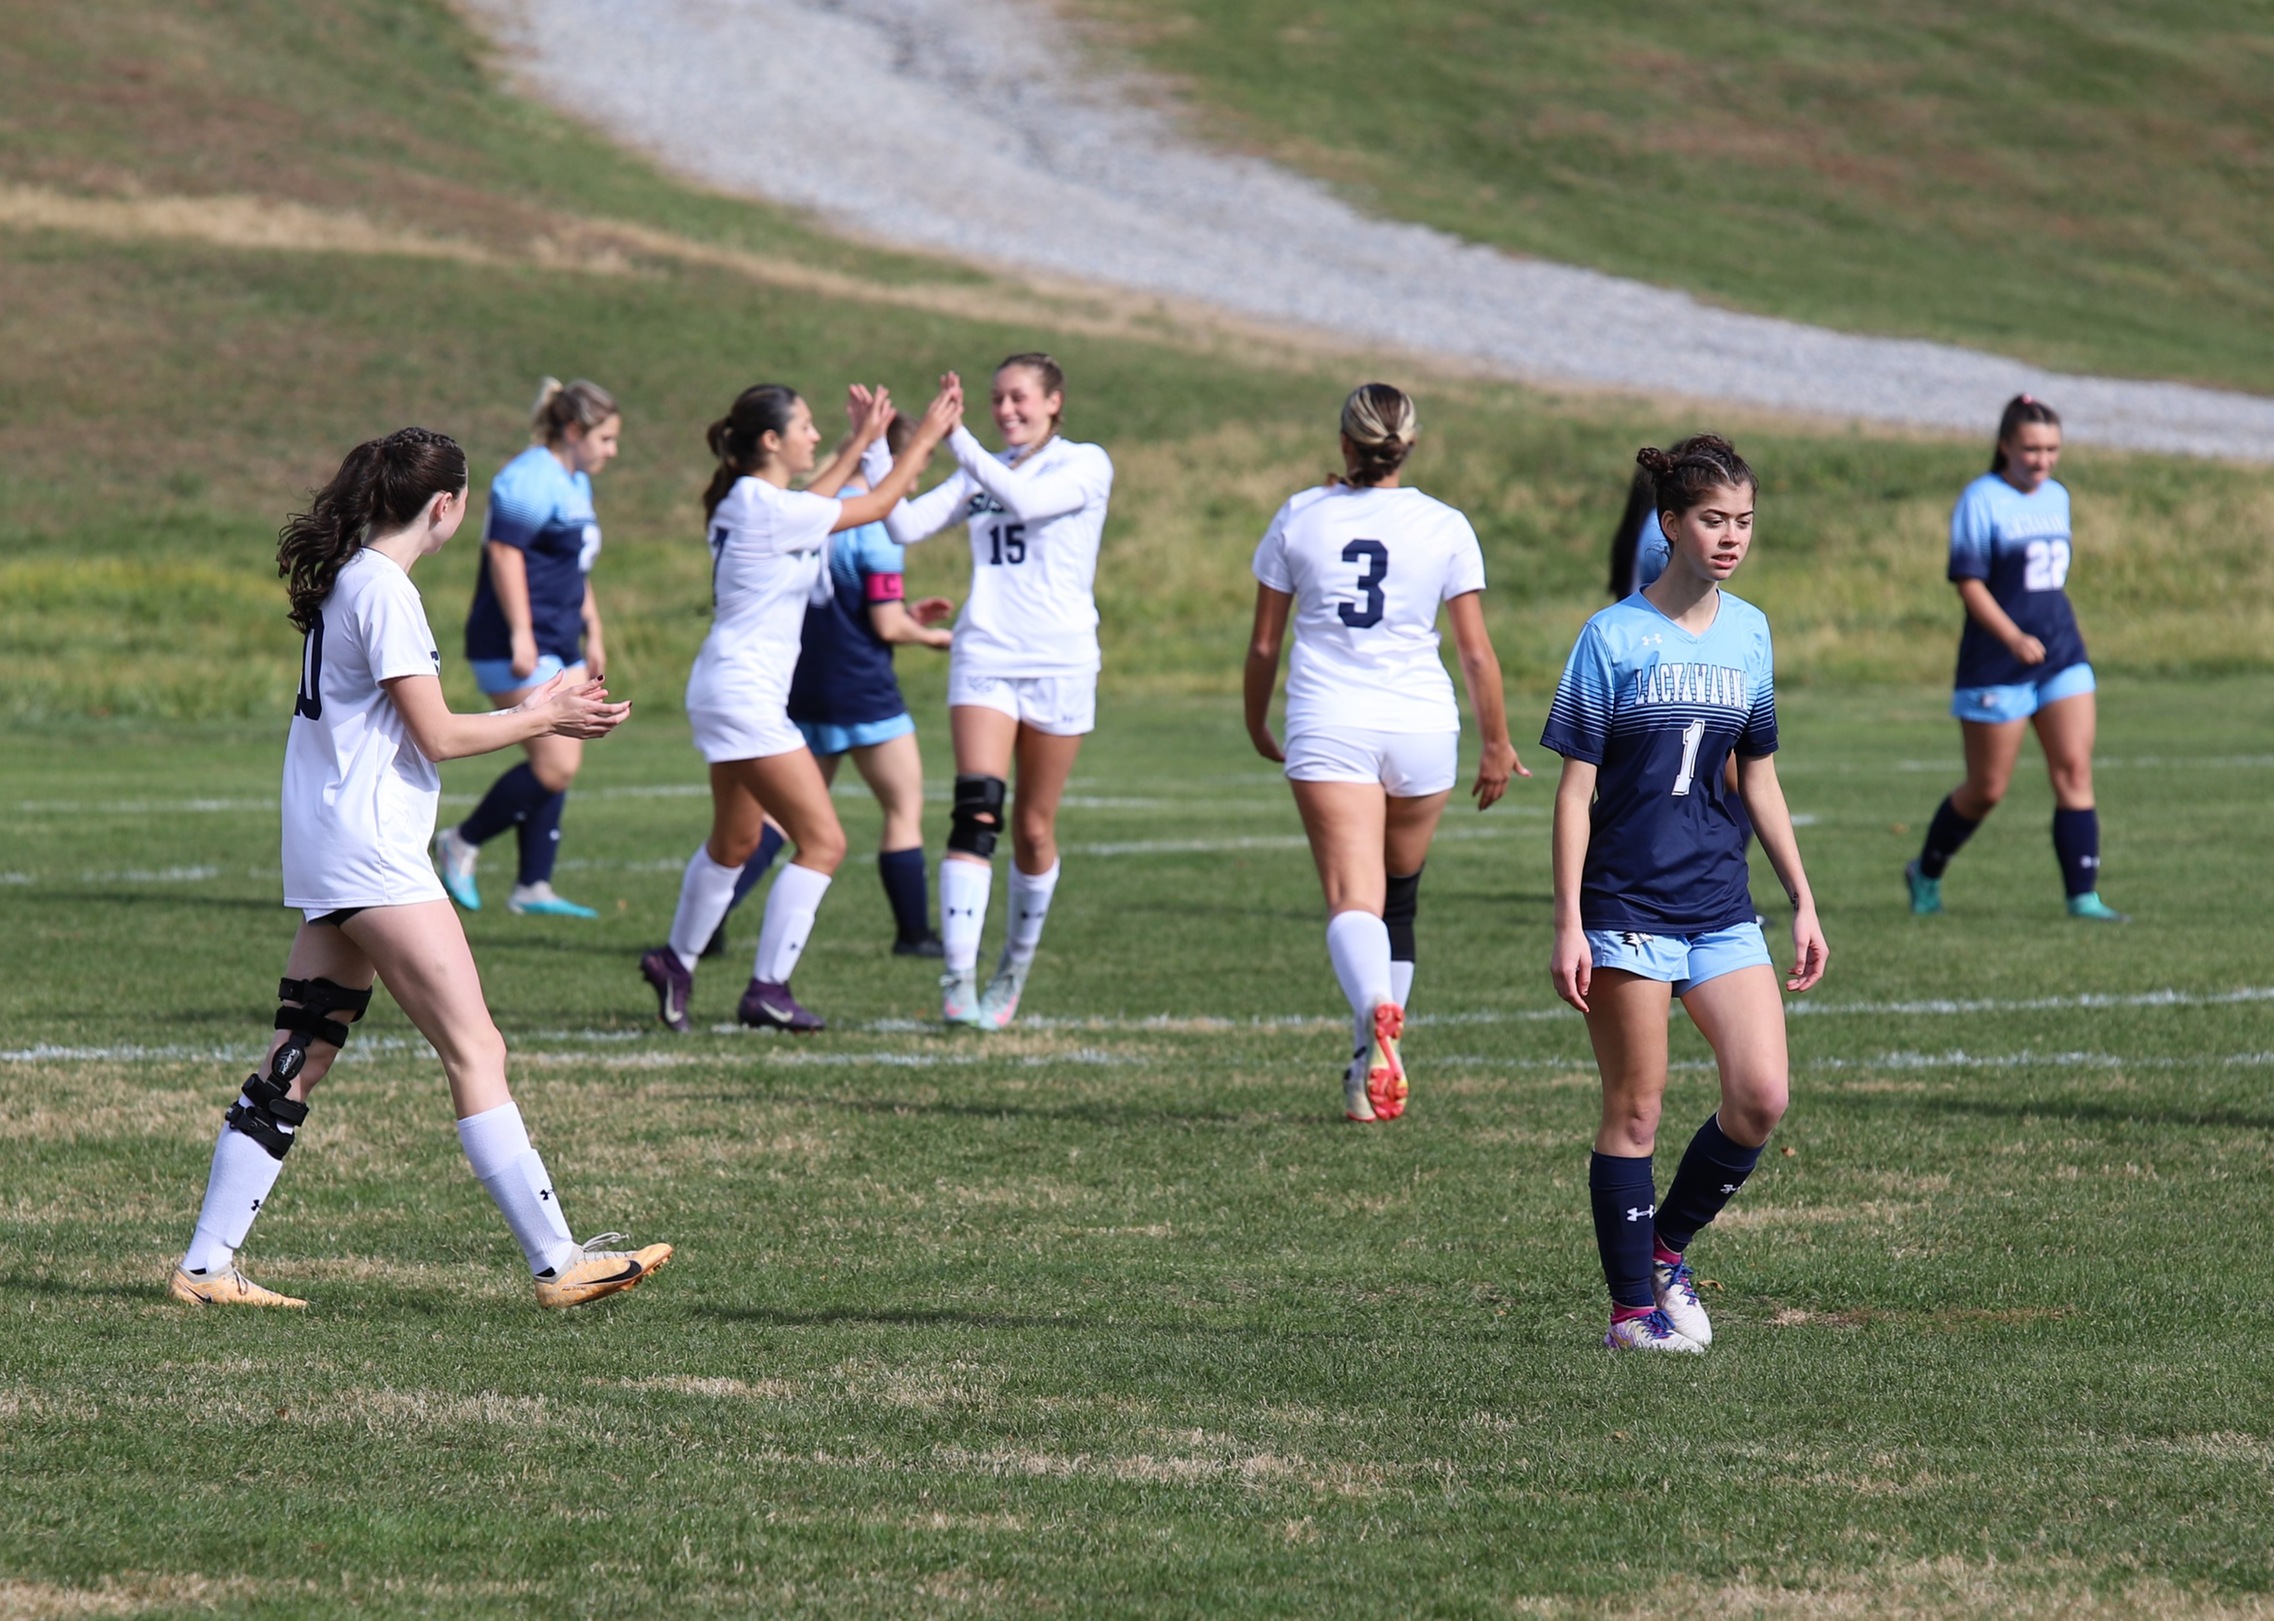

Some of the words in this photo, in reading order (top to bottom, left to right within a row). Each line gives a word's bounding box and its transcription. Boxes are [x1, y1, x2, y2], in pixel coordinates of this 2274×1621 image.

[989, 524, 1025, 565] 15
[1338, 538, 1388, 629] 3
[294, 608, 325, 721] 0
[1671, 719, 1705, 796] 1
